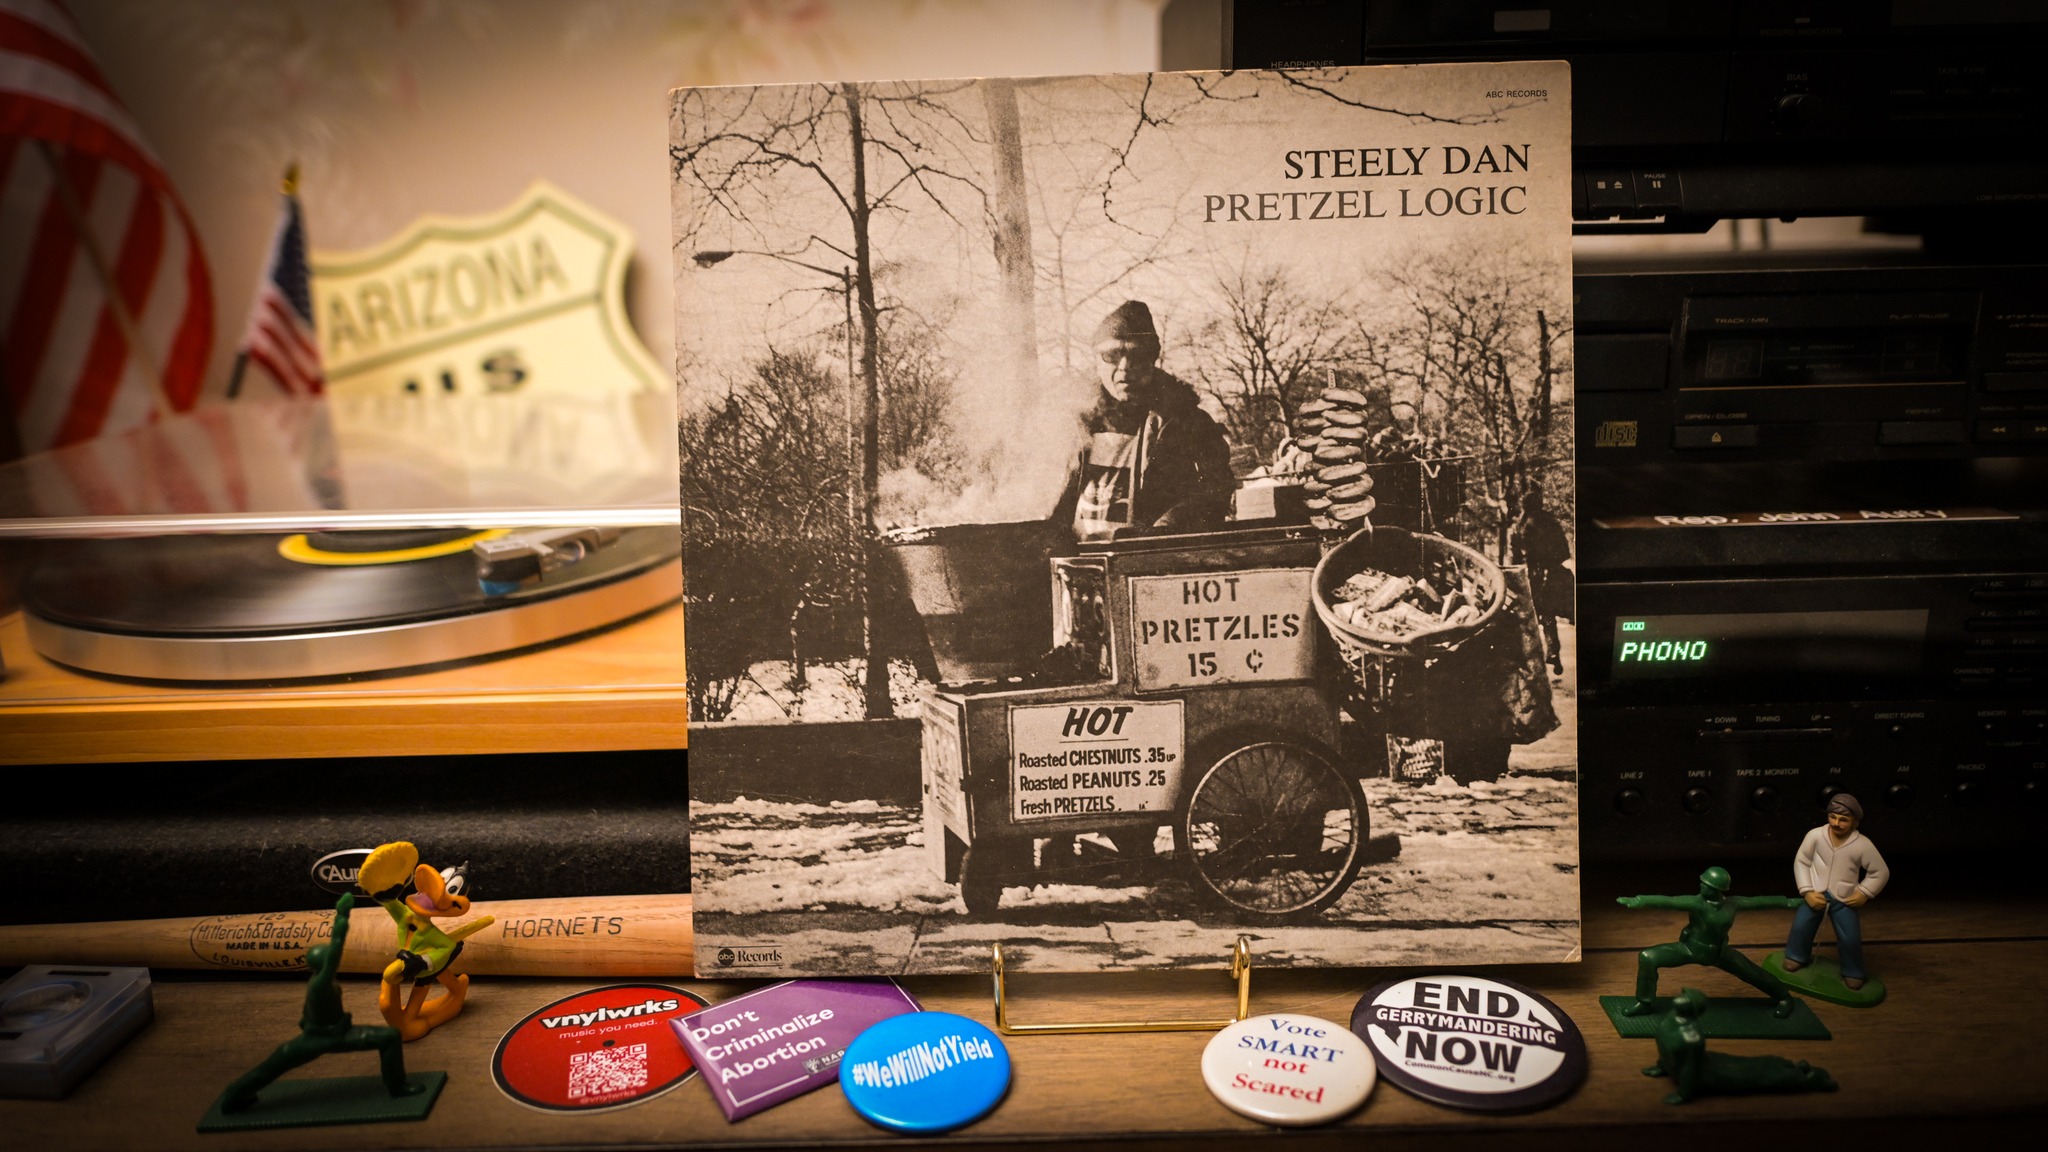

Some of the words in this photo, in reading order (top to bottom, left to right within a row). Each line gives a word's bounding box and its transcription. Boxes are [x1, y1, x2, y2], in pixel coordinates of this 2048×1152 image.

[1786, 72, 1808, 81] BIAS
[1486, 90, 1504, 98] ABC
[1506, 89, 1548, 98] RECORDS
[1284, 147, 1431, 180] STEELY
[1442, 144, 1532, 176] DAN
[1202, 189, 1387, 223] PRETZEL
[1398, 185, 1527, 218] LOGIC
[325, 236, 570, 357] ARIZONA
[1654, 515, 1739, 526] Rep.
[1758, 512, 1841, 522] John
[1183, 577, 1240, 604] HOT
[1141, 613, 1300, 645] PRETZLES
[1188, 652, 1218, 677] 15
[1245, 649, 1264, 673] ¢
[1620, 640, 1707, 662] PHONO
[1062, 706, 1134, 737] HOT
[1714, 716, 1737, 724] DOWN
[1019, 751, 1067, 769] Roasted
[1069, 747, 1141, 766] CHESTNUTS
[1019, 774, 1068, 791] Roasted
[1072, 770, 1141, 789] PEANUTS
[1145, 770, 1166, 787] .25
[1736, 768, 1754, 777] TAPE
[1764, 767, 1799, 776] MONITOR
[1020, 798, 1052, 815] Fresh
[502, 916, 624, 939] HORNETS
[226, 941, 256, 950] MADE
[259, 941, 269, 950] IN
[273, 941, 304, 950] U.S.A.
[738, 950, 783, 963] Records
[1412, 981, 1520, 1019] END
[541, 999, 679, 1029] vnylwrks
[690, 1009, 761, 1042] Don't
[1376, 1007, 1557, 1045] GERRYMANDERING
[559, 1029, 596, 1039] music
[598, 1025, 622, 1036] you
[625, 1019, 658, 1030] need.
[705, 1008, 835, 1061] Criminalize
[1269, 1018, 1327, 1039] Vote
[721, 1035, 827, 1084] Abortion
[852, 1035, 995, 1088] #WeWillNotYield
[1237, 1035, 1344, 1063] SMART
[1404, 1030, 1524, 1074] NOW
[1263, 1058, 1309, 1074] not
[1232, 1073, 1326, 1104] Scared
